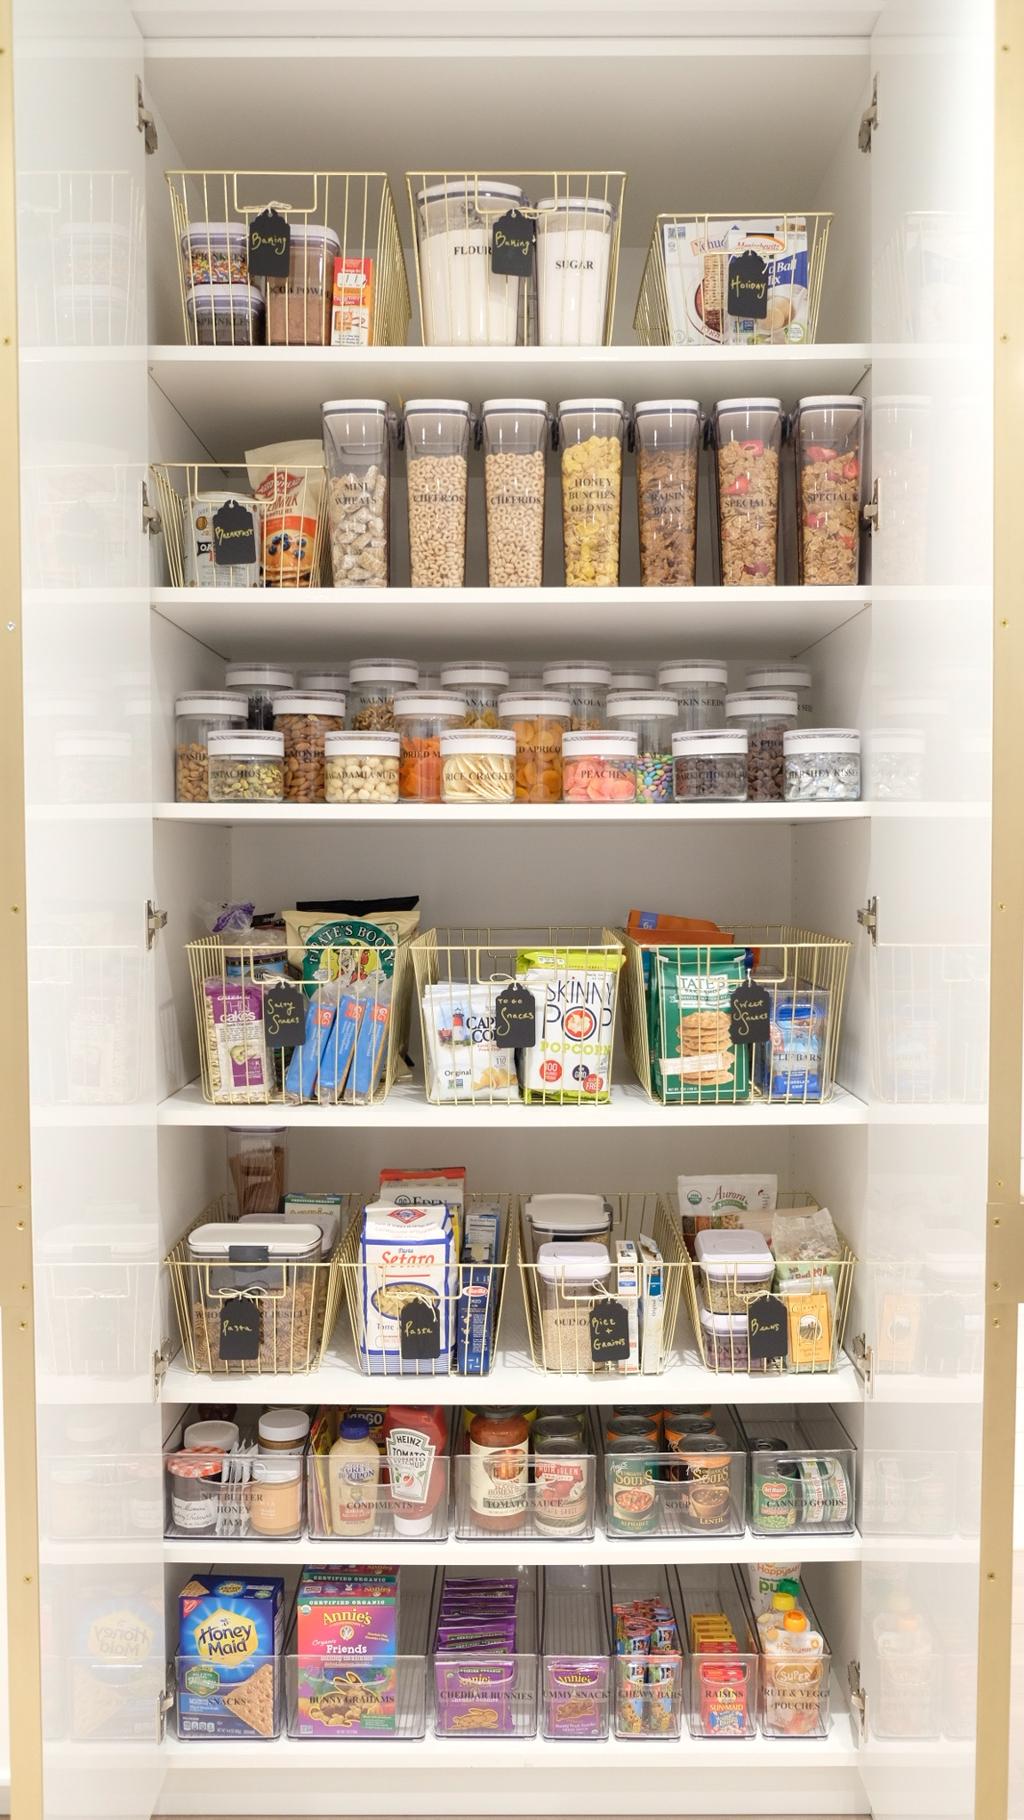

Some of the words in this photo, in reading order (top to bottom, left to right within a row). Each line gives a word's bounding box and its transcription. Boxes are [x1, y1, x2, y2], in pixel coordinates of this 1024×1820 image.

[454, 246, 492, 256] FLOUR
[555, 260, 594, 270] SUGAR
[574, 477, 612, 487] HONEY
[413, 493, 464, 503] CHEERIOS
[490, 495, 541, 505] CHEERIOS
[568, 490, 616, 500] BUNCHES
[650, 492, 685, 501] RAISIN
[807, 493, 849, 502] SPECIAL
[335, 496, 377, 506] WHEATS
[724, 499, 765, 509] SPECIAL
[571, 504, 585, 513] OF
[586, 504, 613, 513] OATS
[653, 506, 682, 515] BRAN
[526, 745, 562, 753] APRICO
[403, 751, 431, 759] DRIED
[581, 769, 628, 779] PEACHES
[547, 977, 614, 1006] SKINNY
[466, 1016, 497, 1030] CAP
[542, 1004, 613, 1042] POP
[540, 1041, 612, 1056] POPCORN
[444, 1069, 471, 1077] Orginal
[708, 1184, 746, 1203] Aurora
[396, 1435, 422, 1447] HEINZ
[346, 1501, 413, 1510] CONDIMENTS
[486, 1500, 528, 1508] TOMATO
[531, 1499, 563, 1508] SAUCE
[809, 1499, 845, 1507] GOODS
[217, 1506, 251, 1514] HONEY
[322, 1608, 373, 1626] Annie's
[199, 1625, 252, 1645] Honey
[207, 1639, 248, 1656] Maid
[326, 1644, 368, 1654] Friends
[440, 1691, 488, 1700] CHEDDAR
[490, 1691, 533, 1700] BUNNIES
[705, 1689, 744, 1698] RAISINS
[207, 1697, 247, 1706] SNACKS
[309, 1696, 342, 1704] BUNNY
[344, 1695, 395, 1704] GRAHAMS
[772, 1702, 821, 1711] POUCHES
